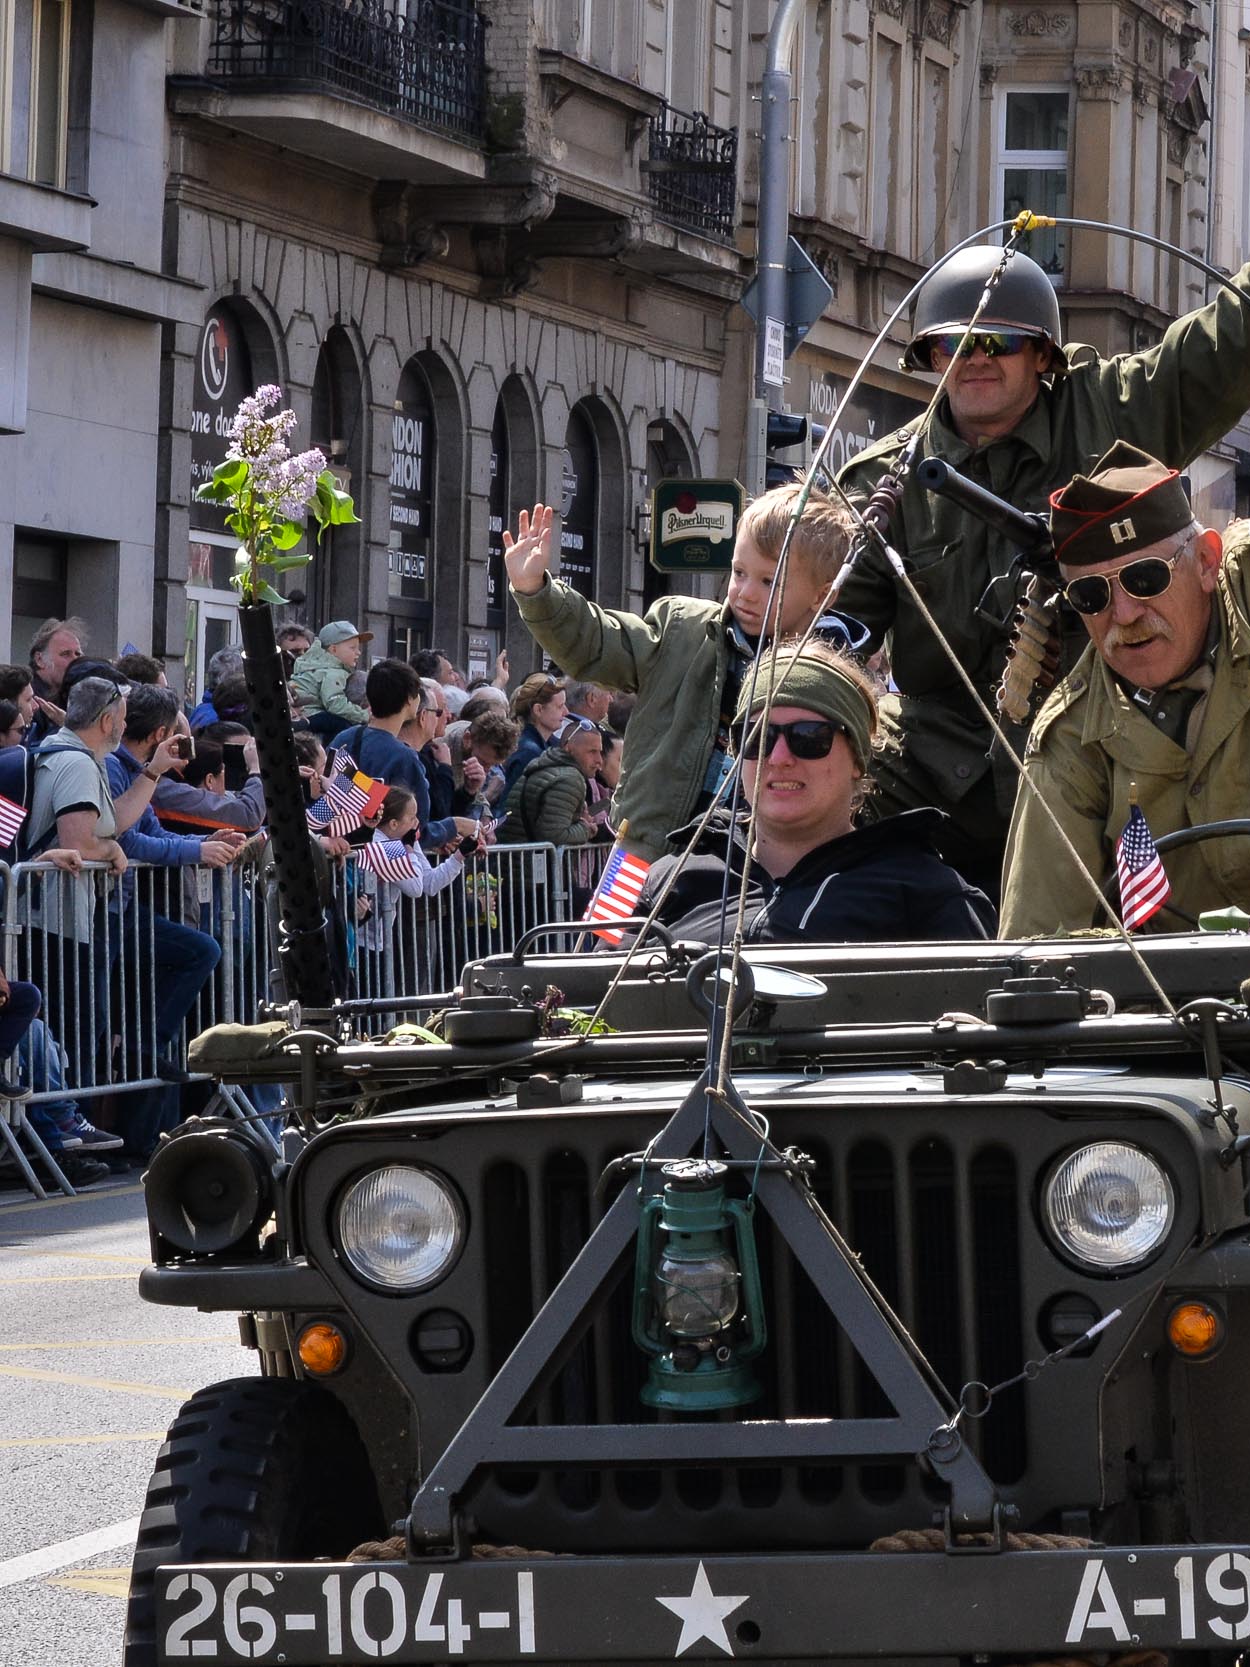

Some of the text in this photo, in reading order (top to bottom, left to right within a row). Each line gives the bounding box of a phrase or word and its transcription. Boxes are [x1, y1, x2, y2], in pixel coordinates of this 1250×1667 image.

[810, 374, 838, 416] MÓDA
[667, 512, 725, 535] Pilsner Urquell
